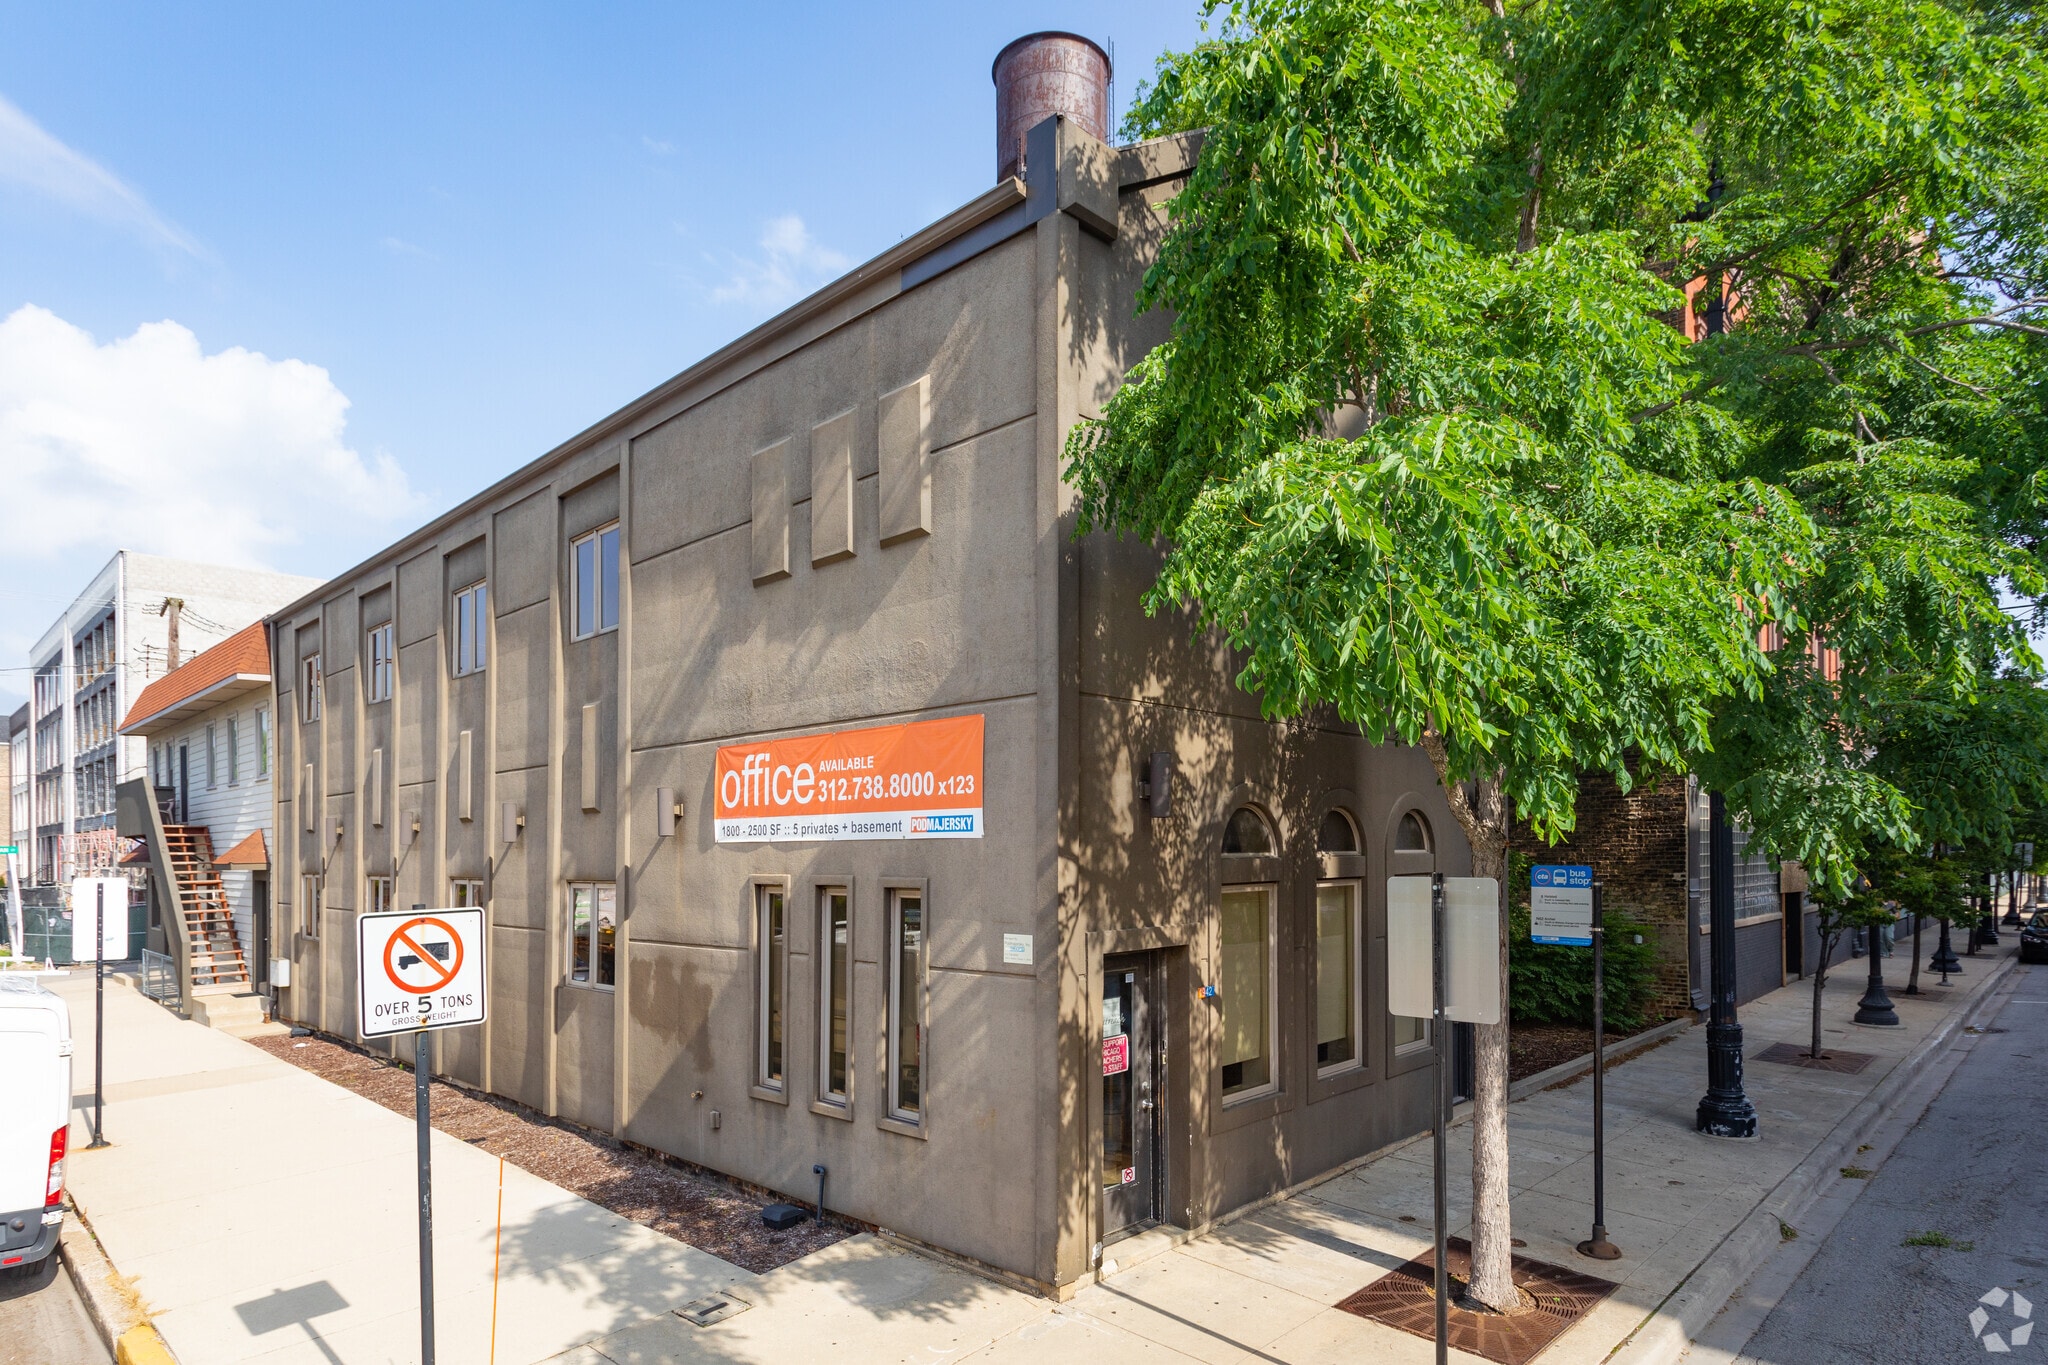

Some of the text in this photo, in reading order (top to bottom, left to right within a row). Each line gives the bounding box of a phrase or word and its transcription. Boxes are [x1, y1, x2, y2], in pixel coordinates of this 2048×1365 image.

[819, 756, 874, 772] AVAILABLE
[721, 753, 815, 809] office
[818, 771, 975, 802] 312.738.8000 x123
[748, 824, 768, 836] 2500
[770, 824, 781, 836] SF
[793, 823, 799, 834] 5
[801, 822, 839, 837] privates
[851, 820, 902, 834] basement
[911, 816, 973, 832] PODMAJERSKY
[1569, 869, 1586, 877] bus
[1569, 877, 1589, 886] stop
[375, 994, 473, 1017] OVER 5 TONS
[392, 1011, 457, 1026] GROSS WEIGHT
[1103, 1038, 1125, 1048] SUPPORT
[1103, 1047, 1120, 1057] HICAGO
[1103, 1055, 1122, 1064] ACHERS
[1108, 1063, 1123, 1072] STAFF
